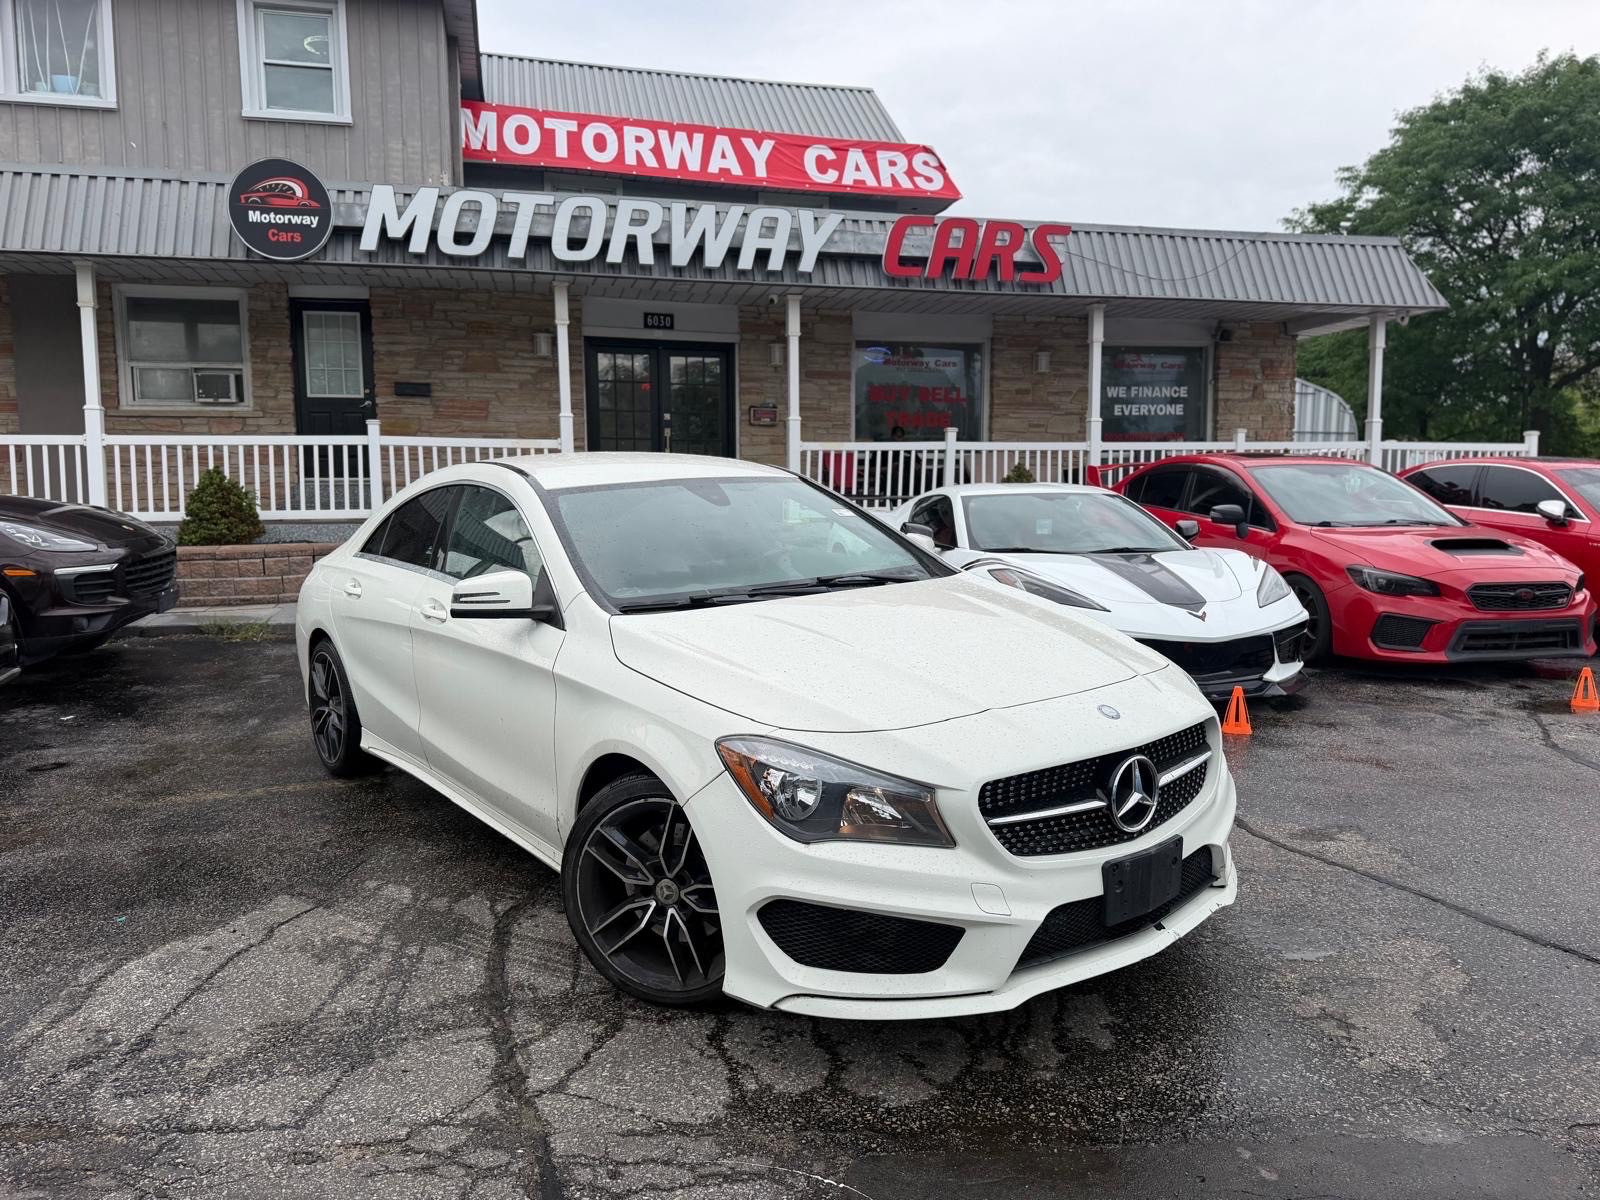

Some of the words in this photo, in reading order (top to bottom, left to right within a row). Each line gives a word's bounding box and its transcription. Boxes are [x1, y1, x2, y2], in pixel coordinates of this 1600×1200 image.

[461, 107, 775, 179] MOTORWAY
[803, 144, 946, 193] CARS
[248, 210, 319, 228] Motorway
[267, 229, 302, 242] Cars
[359, 184, 846, 273] MOTORWAY
[881, 214, 1073, 284] CARS
[647, 314, 671, 327] 6030
[934, 359, 957, 368] Cars
[1113, 360, 1157, 369] orway
[1106, 386, 1127, 398] WE
[1131, 386, 1189, 398] FINANCE
[1113, 404, 1185, 416] EVERYONE
